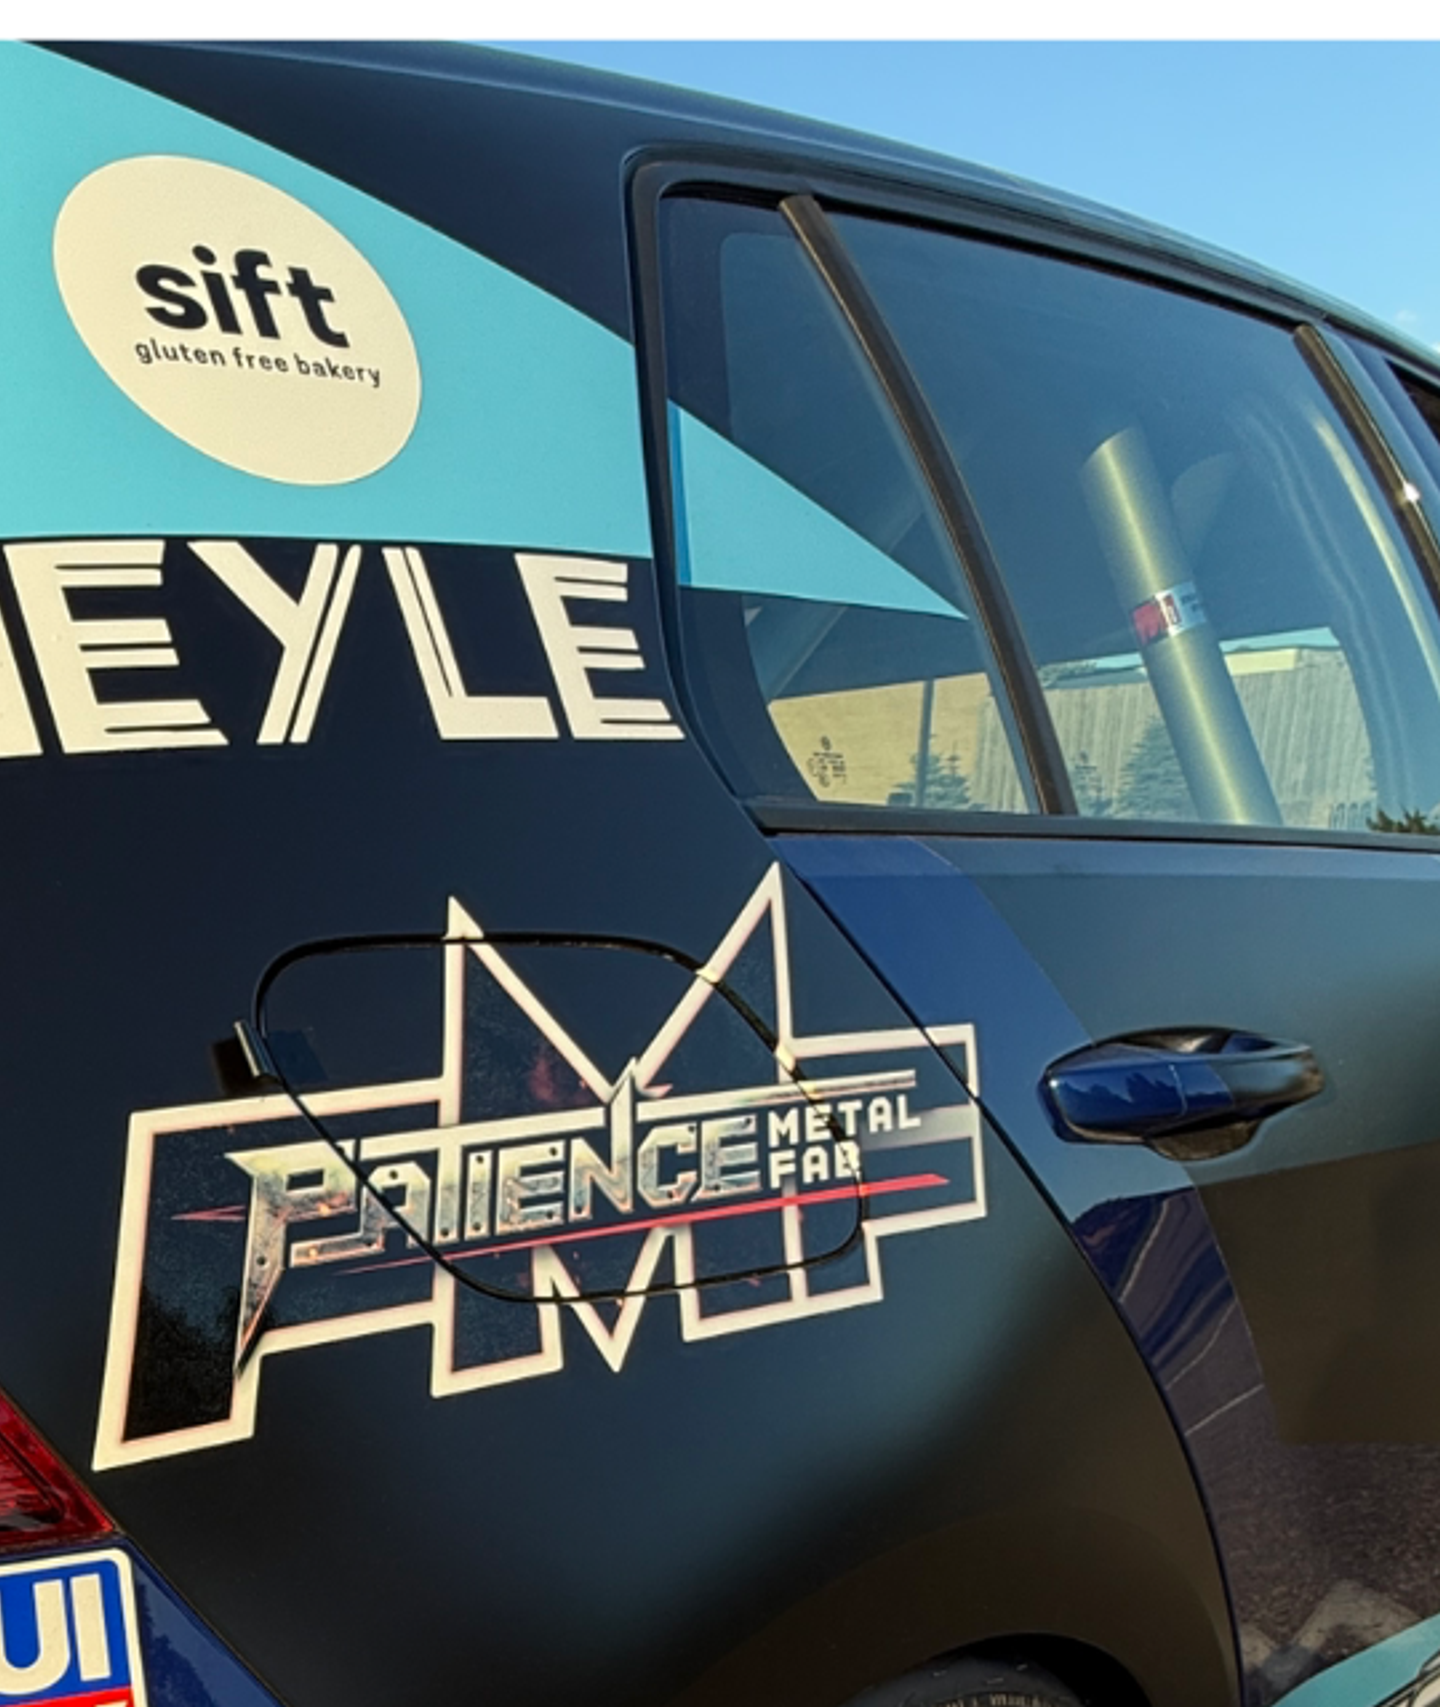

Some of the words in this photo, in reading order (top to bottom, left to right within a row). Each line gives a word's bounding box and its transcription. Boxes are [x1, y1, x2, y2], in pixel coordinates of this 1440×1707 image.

[135, 244, 351, 349] sift
[135, 338, 227, 366] gluten
[231, 347, 289, 374] free
[294, 353, 381, 389] bakery
[766, 1093, 922, 1148] METAL
[769, 1143, 863, 1188] FAB
